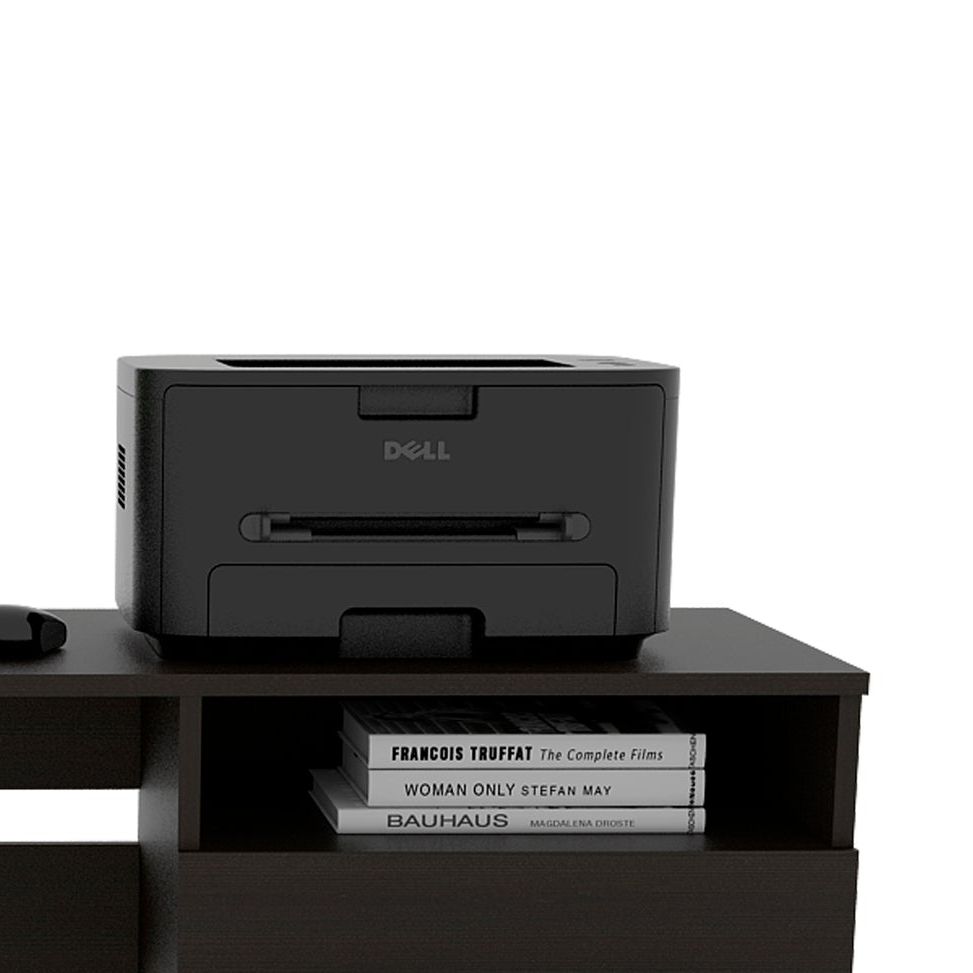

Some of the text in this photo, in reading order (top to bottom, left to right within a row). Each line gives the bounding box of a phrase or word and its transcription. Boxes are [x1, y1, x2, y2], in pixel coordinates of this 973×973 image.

[383, 440, 451, 461] DELL
[392, 746, 664, 763] FRANCOIS TRUFFAT The Complete Films
[404, 783, 612, 797] WOMAN ONLY STEFAN MAY
[387, 813, 636, 828] BAUHAUS MAGDALENA DROSTE
